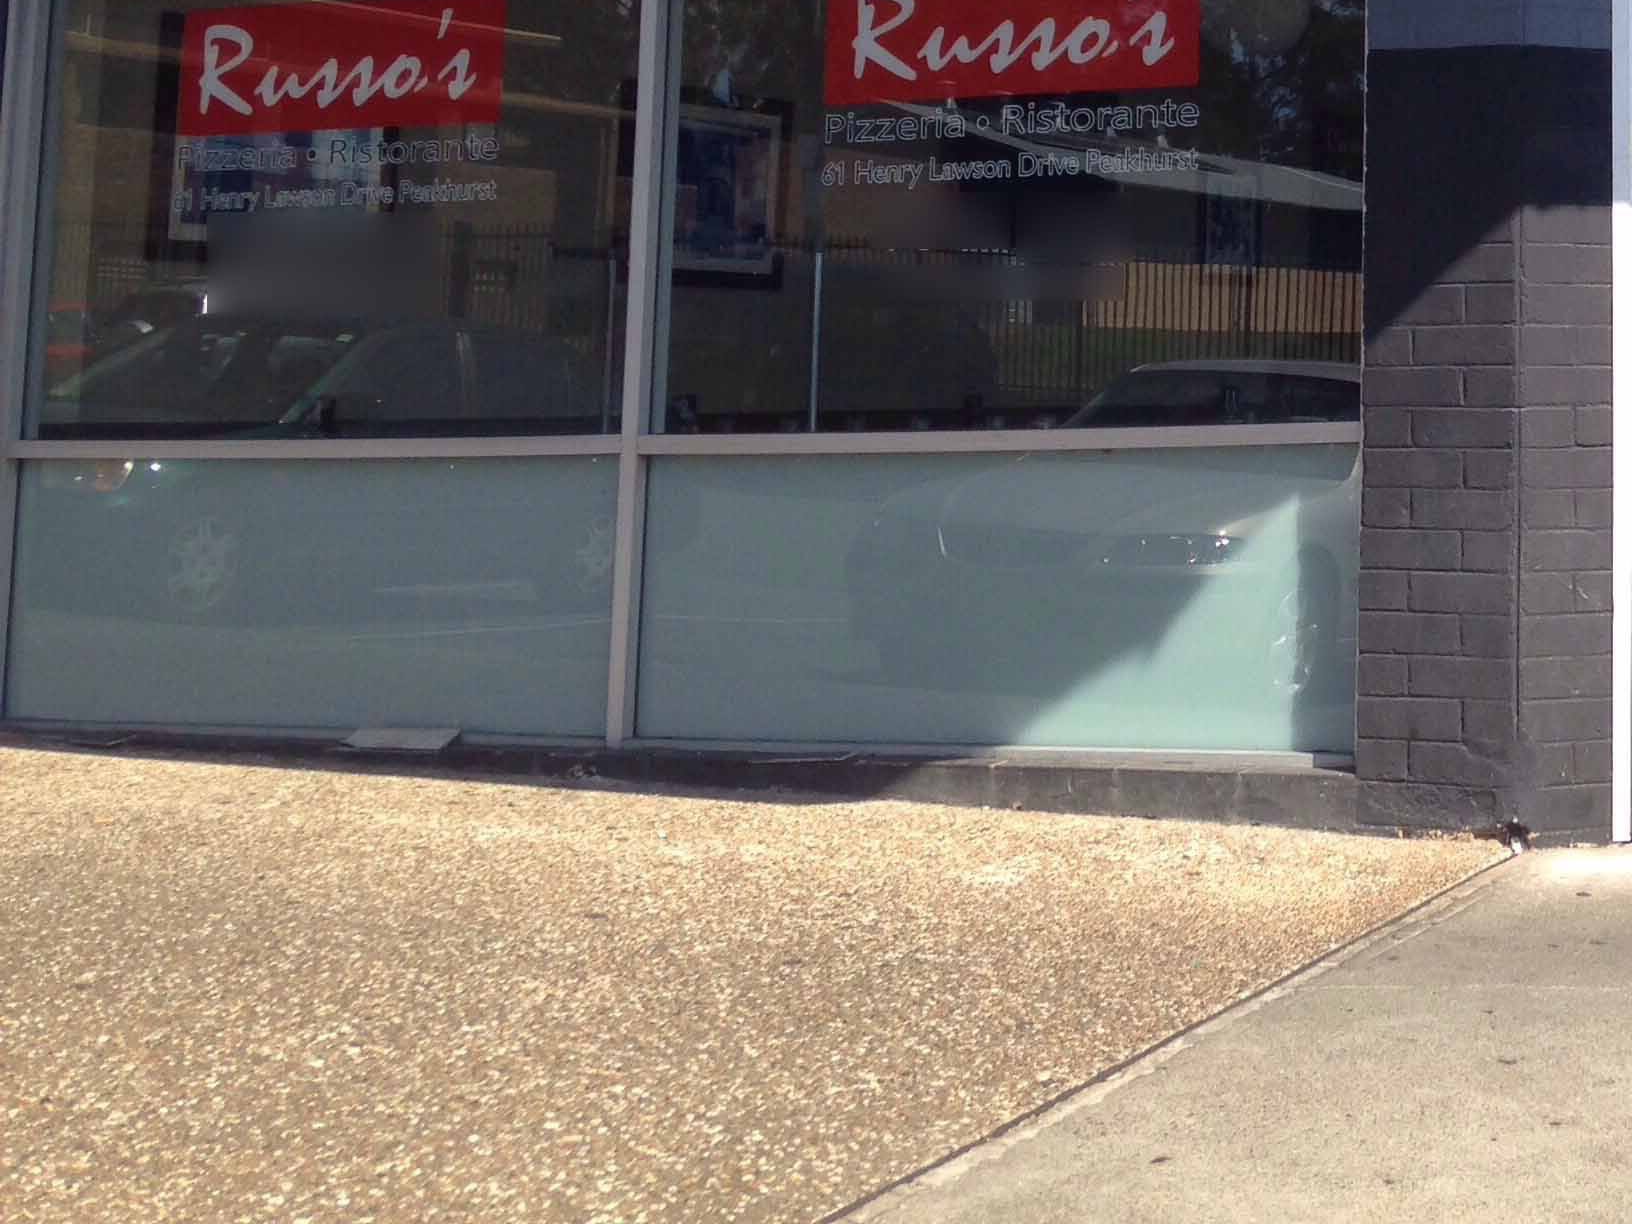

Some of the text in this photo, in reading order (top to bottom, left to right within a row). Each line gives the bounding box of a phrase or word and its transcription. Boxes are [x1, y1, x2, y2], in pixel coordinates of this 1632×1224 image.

[198, 7, 478, 117] Russo's
[823, 98, 1201, 145] Pizzeria Ristorante
[327, 132, 500, 167] Ristorante
[821, 161, 846, 187] 61
[853, 160, 923, 190] Henry
[928, 152, 1012, 182] Lawson
[1017, 151, 1081, 177] Drive
